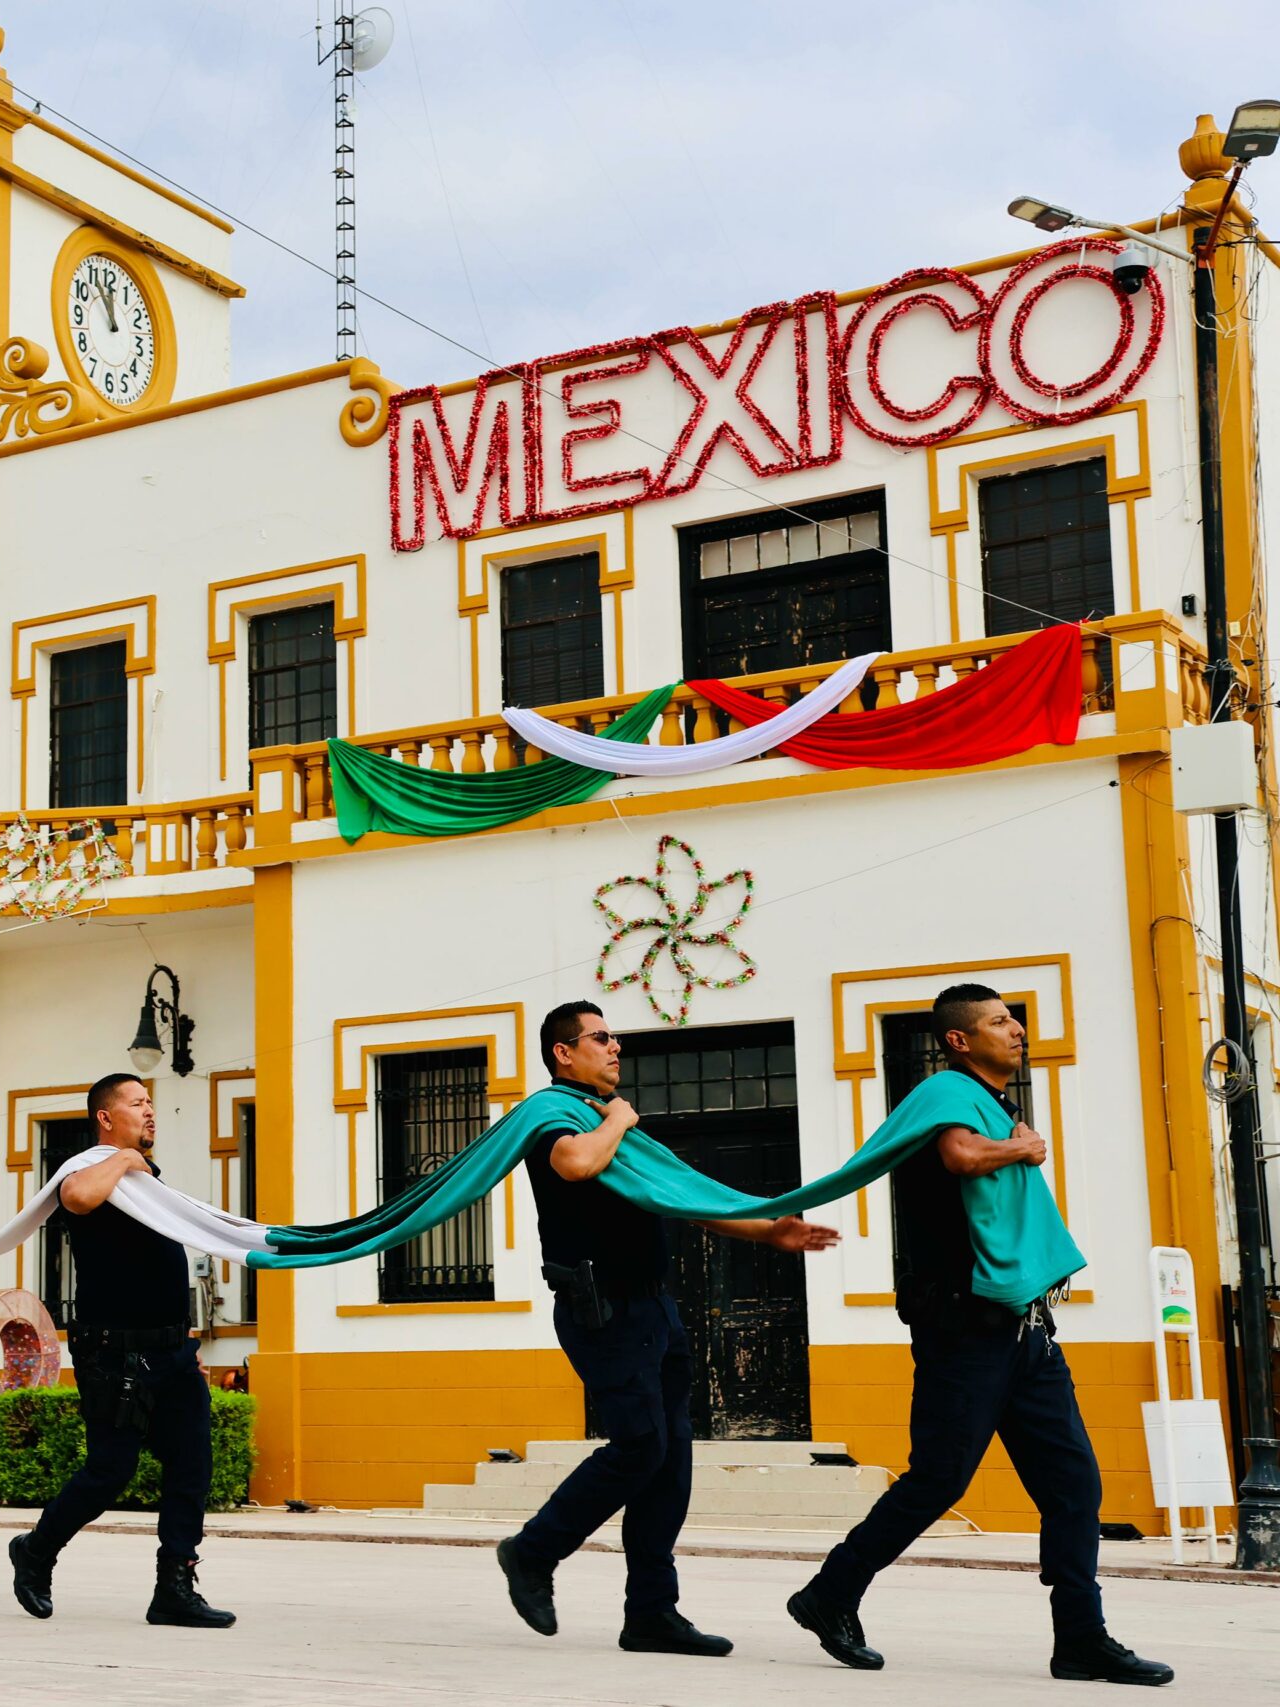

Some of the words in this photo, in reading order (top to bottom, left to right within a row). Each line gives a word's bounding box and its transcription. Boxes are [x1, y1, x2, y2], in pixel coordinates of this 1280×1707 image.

[75, 280, 88, 301] 10
[123, 286, 128, 305] 1
[74, 305, 83, 325] 9
[134, 308, 142, 329] 2
[79, 332, 87, 352] 8
[136, 336, 143, 356] 3
[89, 357, 97, 378] 7
[130, 358, 138, 377] 4
[105, 373, 113, 393] 6
[121, 374, 129, 393] 5
[387, 237, 1165, 553] MEXICO
